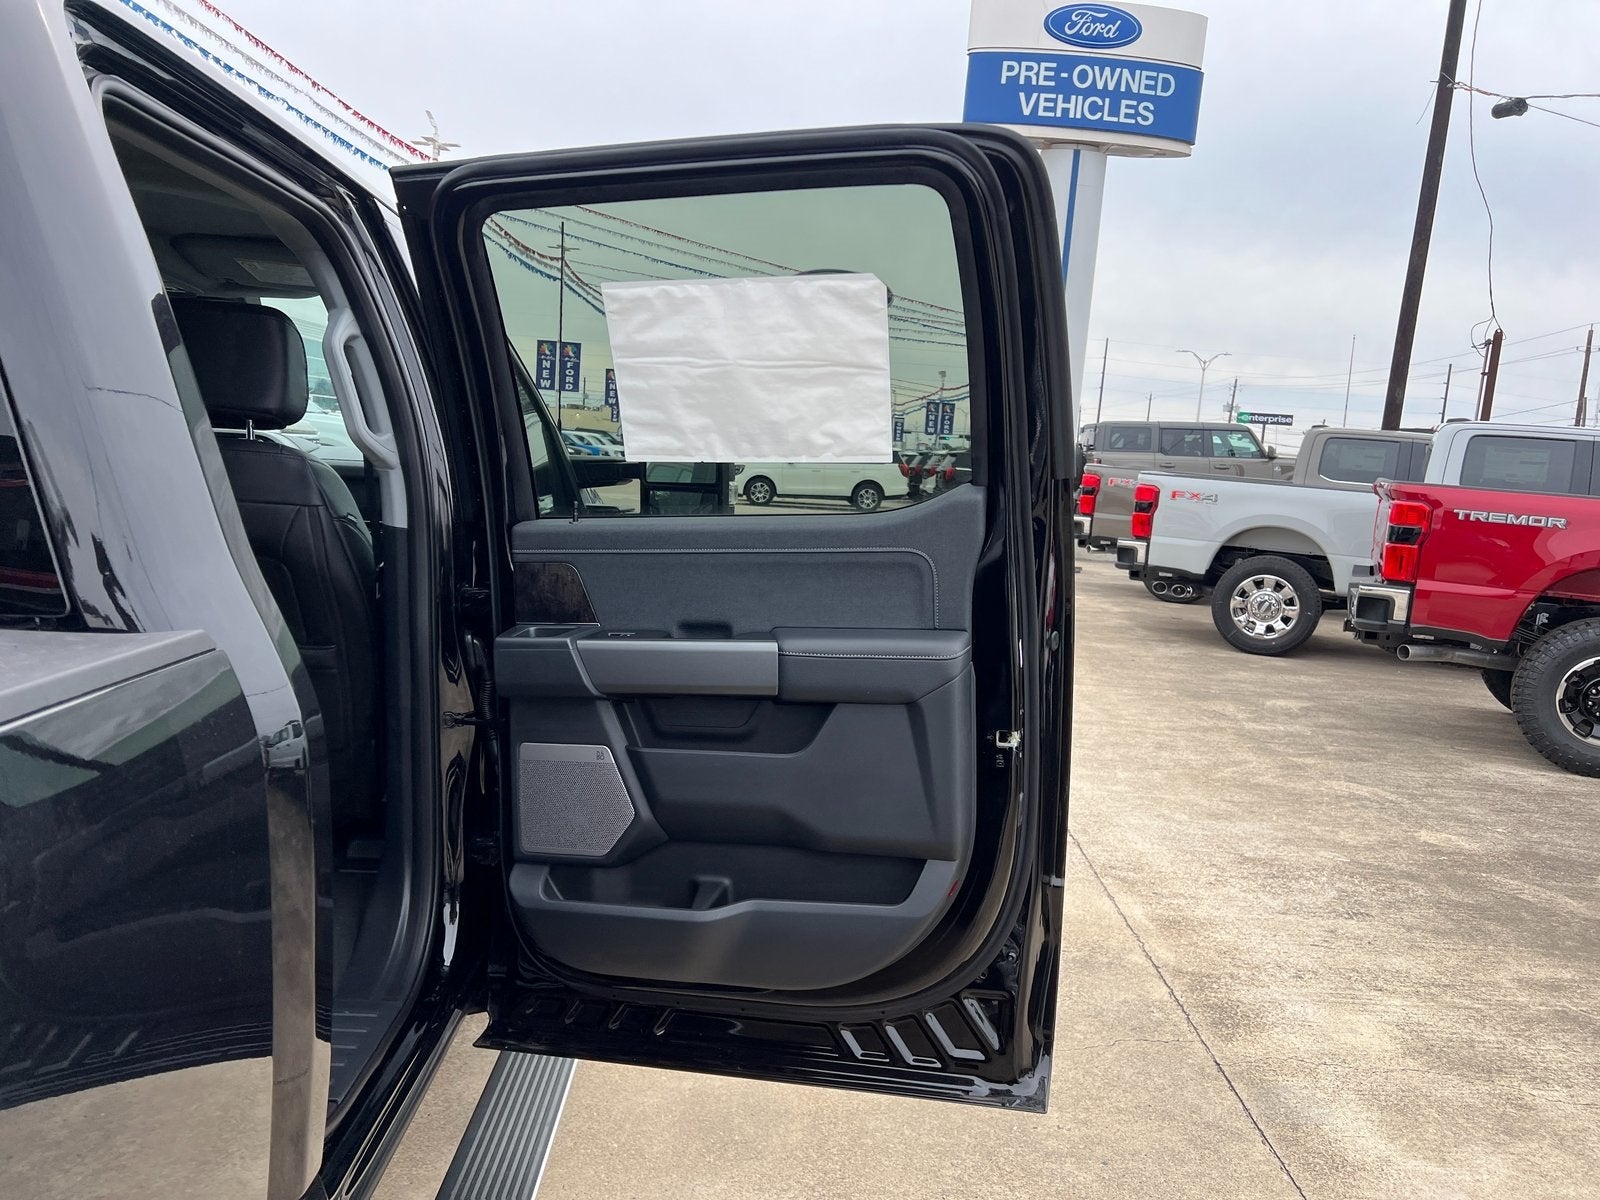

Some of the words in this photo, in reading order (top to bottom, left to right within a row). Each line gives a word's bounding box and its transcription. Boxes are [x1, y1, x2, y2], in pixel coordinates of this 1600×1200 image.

[1065, 10, 1121, 39] Ford
[1019, 92, 1155, 126] VEHICLES
[540, 360, 551, 388] NEW
[565, 362, 574, 390] FORD
[608, 383, 617, 404] NEW
[1239, 414, 1293, 423] enterprise
[1170, 488, 1218, 505] FX4
[1453, 509, 1567, 529] TREMOR
